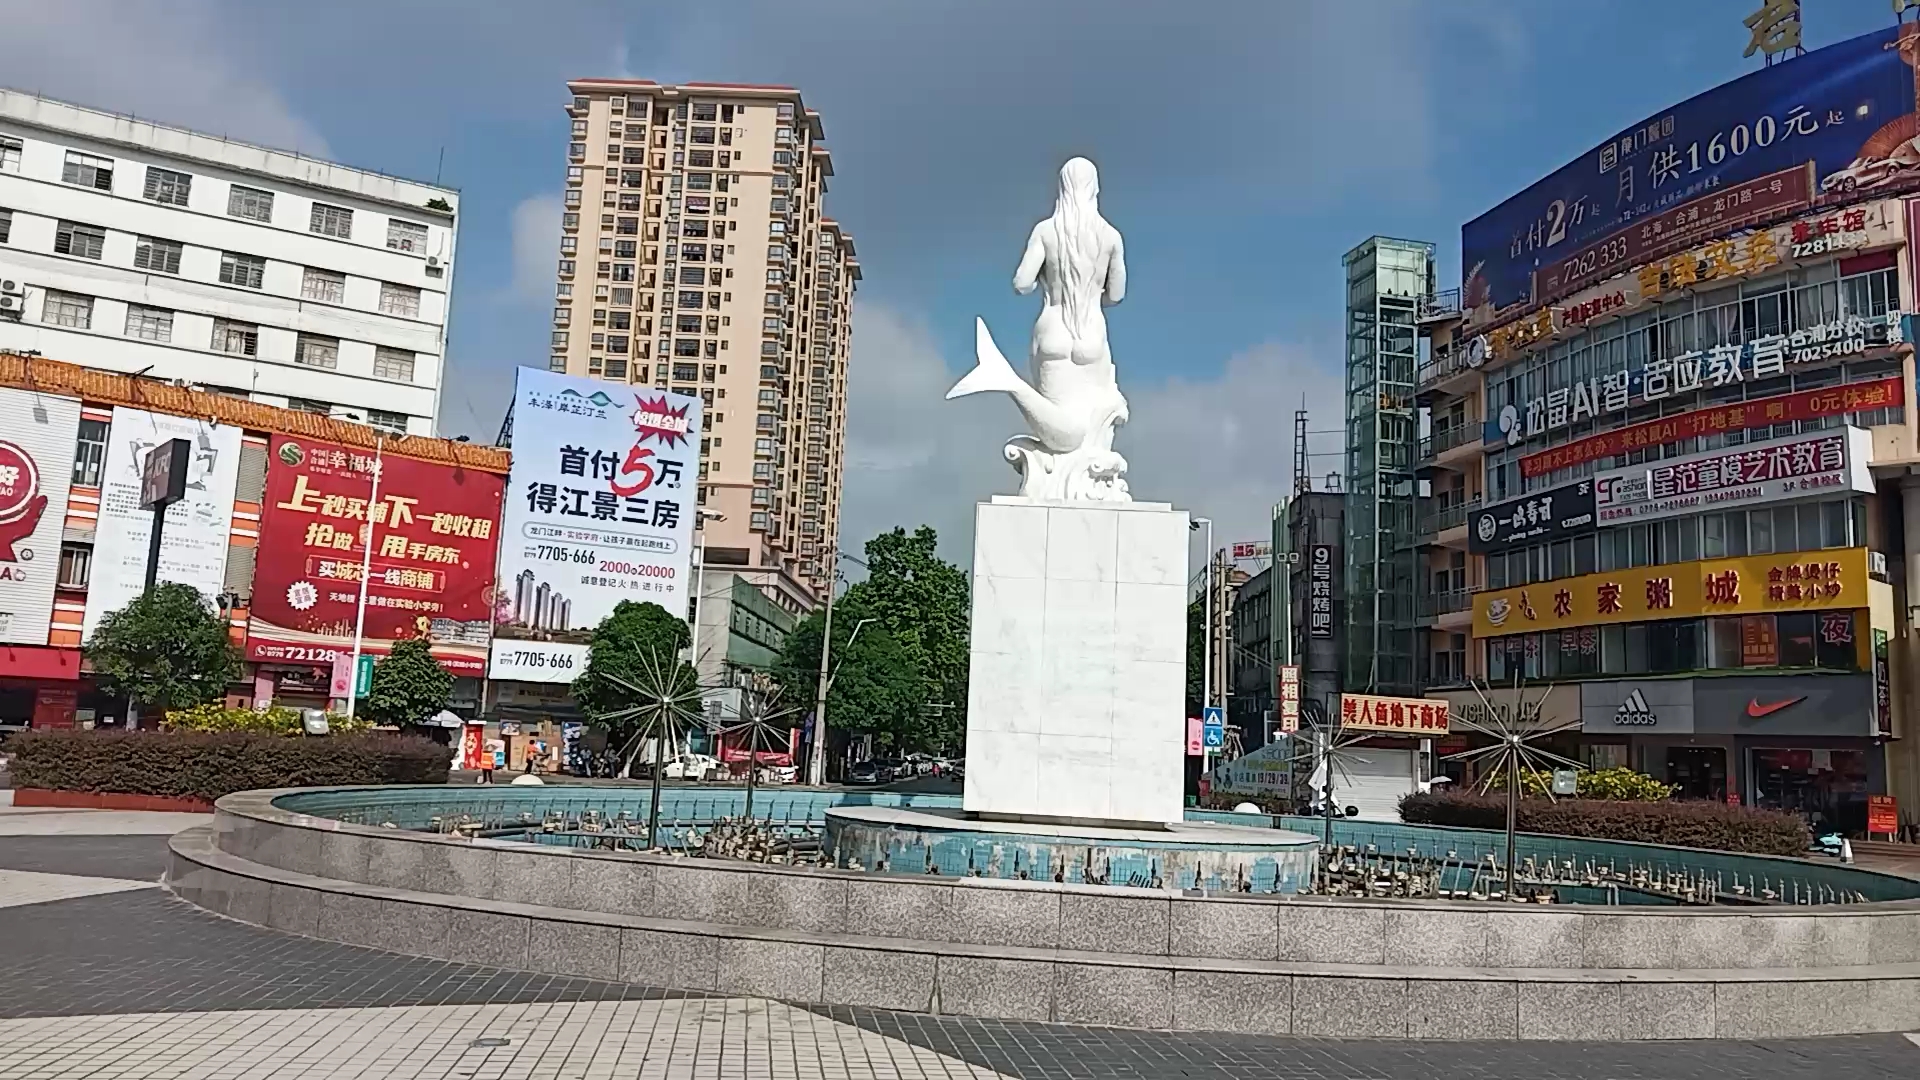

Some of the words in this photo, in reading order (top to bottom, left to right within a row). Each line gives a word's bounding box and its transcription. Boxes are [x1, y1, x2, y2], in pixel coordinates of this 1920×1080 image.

[1563, 250, 1596, 284] 7262
[1600, 236, 1628, 267] 333
[1791, 338, 1865, 363] 7025400
[560, 444, 684, 497] 首付5万
[1653, 438, 1843, 499] 星范童模艺术教育
[526, 482, 680, 529] 得江景三房
[537, 545, 596, 565] 7705-666
[1312, 547, 1330, 628] 9号烧烤吧
[514, 652, 573, 669] 7705-666
[1343, 698, 1449, 730] 美人鱼地下商场
[1613, 712, 1656, 725] adidas
